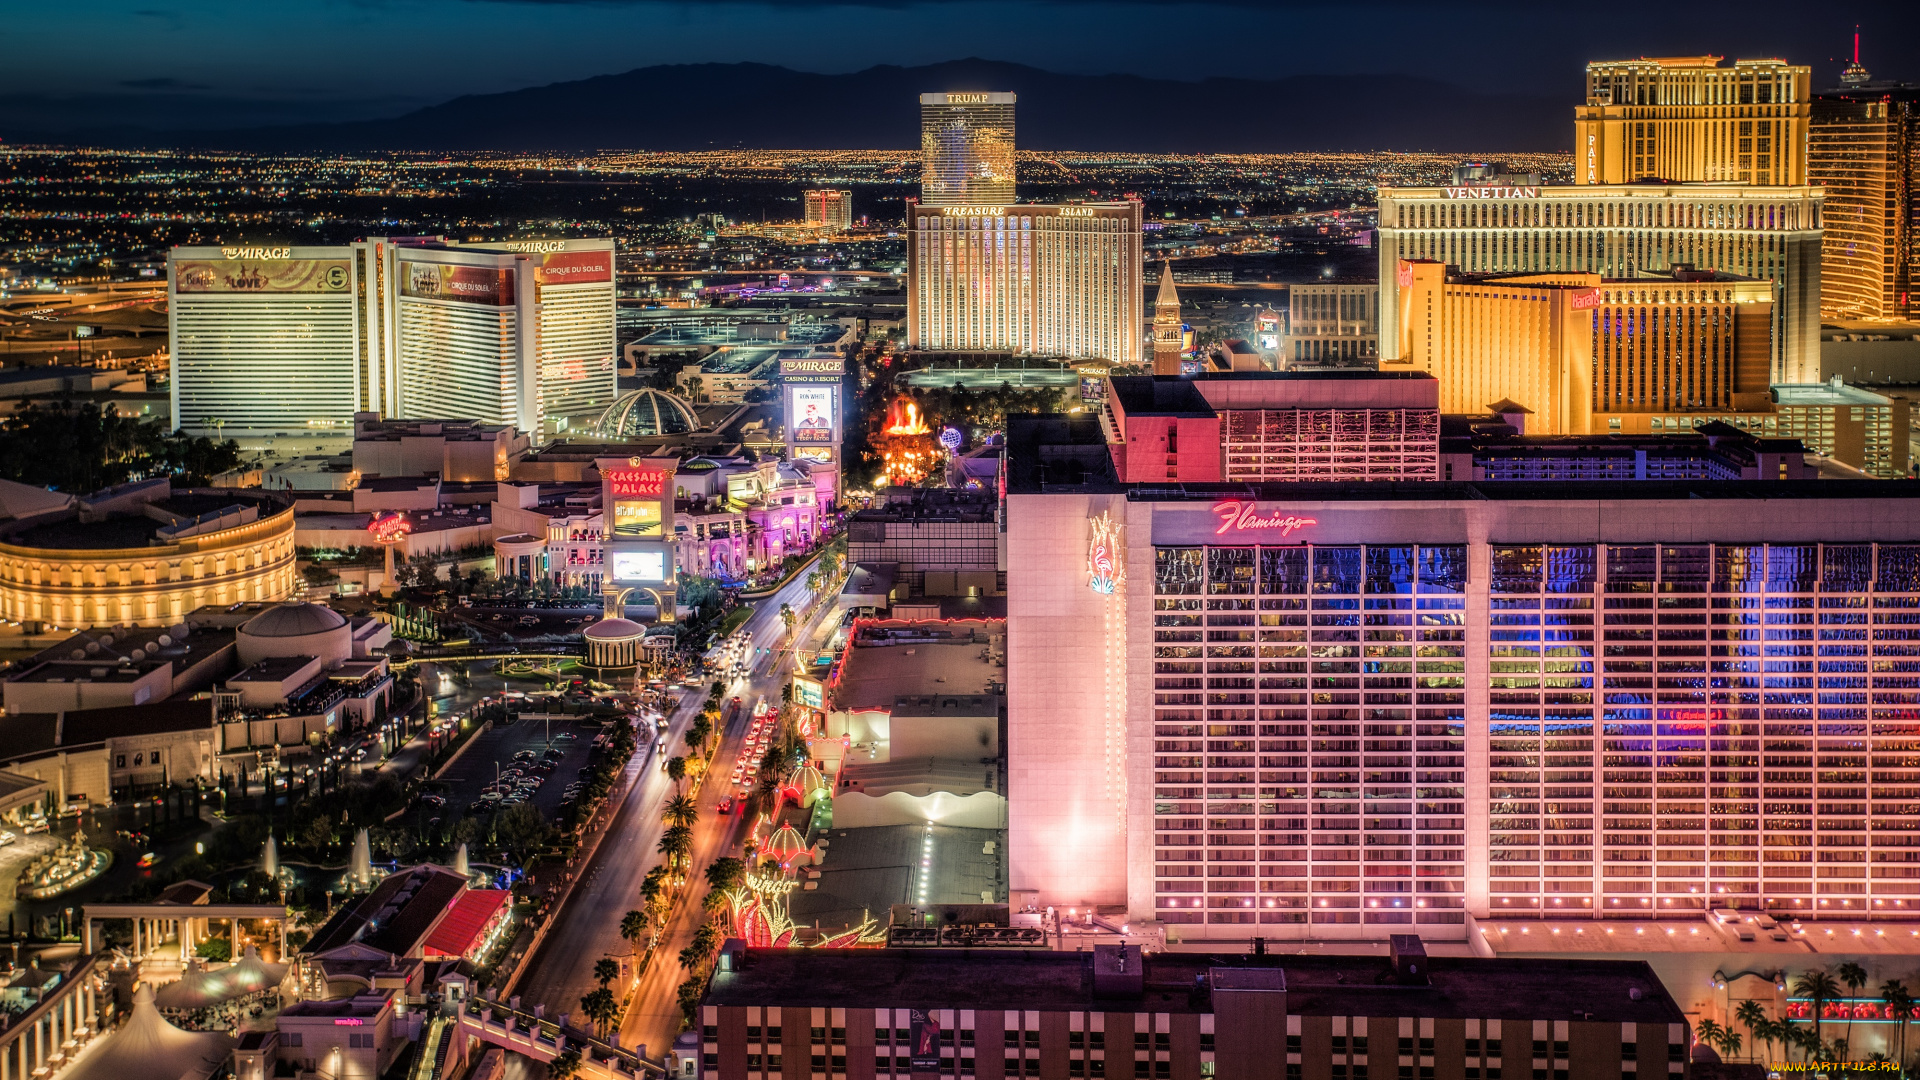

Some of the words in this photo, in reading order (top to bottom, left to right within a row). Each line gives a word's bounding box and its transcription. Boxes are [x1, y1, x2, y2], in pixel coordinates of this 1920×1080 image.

[946, 94, 988, 103] TRUMP
[1445, 187, 1537, 199] VENETIAN
[943, 207, 1005, 216] TREASURE
[1059, 207, 1094, 216] ISLAND
[221, 247, 238, 256] THE
[515, 241, 565, 253] MIRAGE
[226, 247, 291, 260] MIRAGE
[545, 266, 570, 275] CIRQUE
[583, 265, 605, 273] SOLEIL
[231, 277, 261, 288] LOVE
[451, 281, 468, 292] CIRQUE
[474, 284, 490, 292] SOLEIL
[787, 361, 842, 373] MIRAGE
[609, 472, 664, 483] CAESARS
[613, 483, 662, 494] PALACE
[615, 505, 635, 516] elton
[635, 507, 648, 519] john
[1213, 501, 1317, 537] Flamingo
